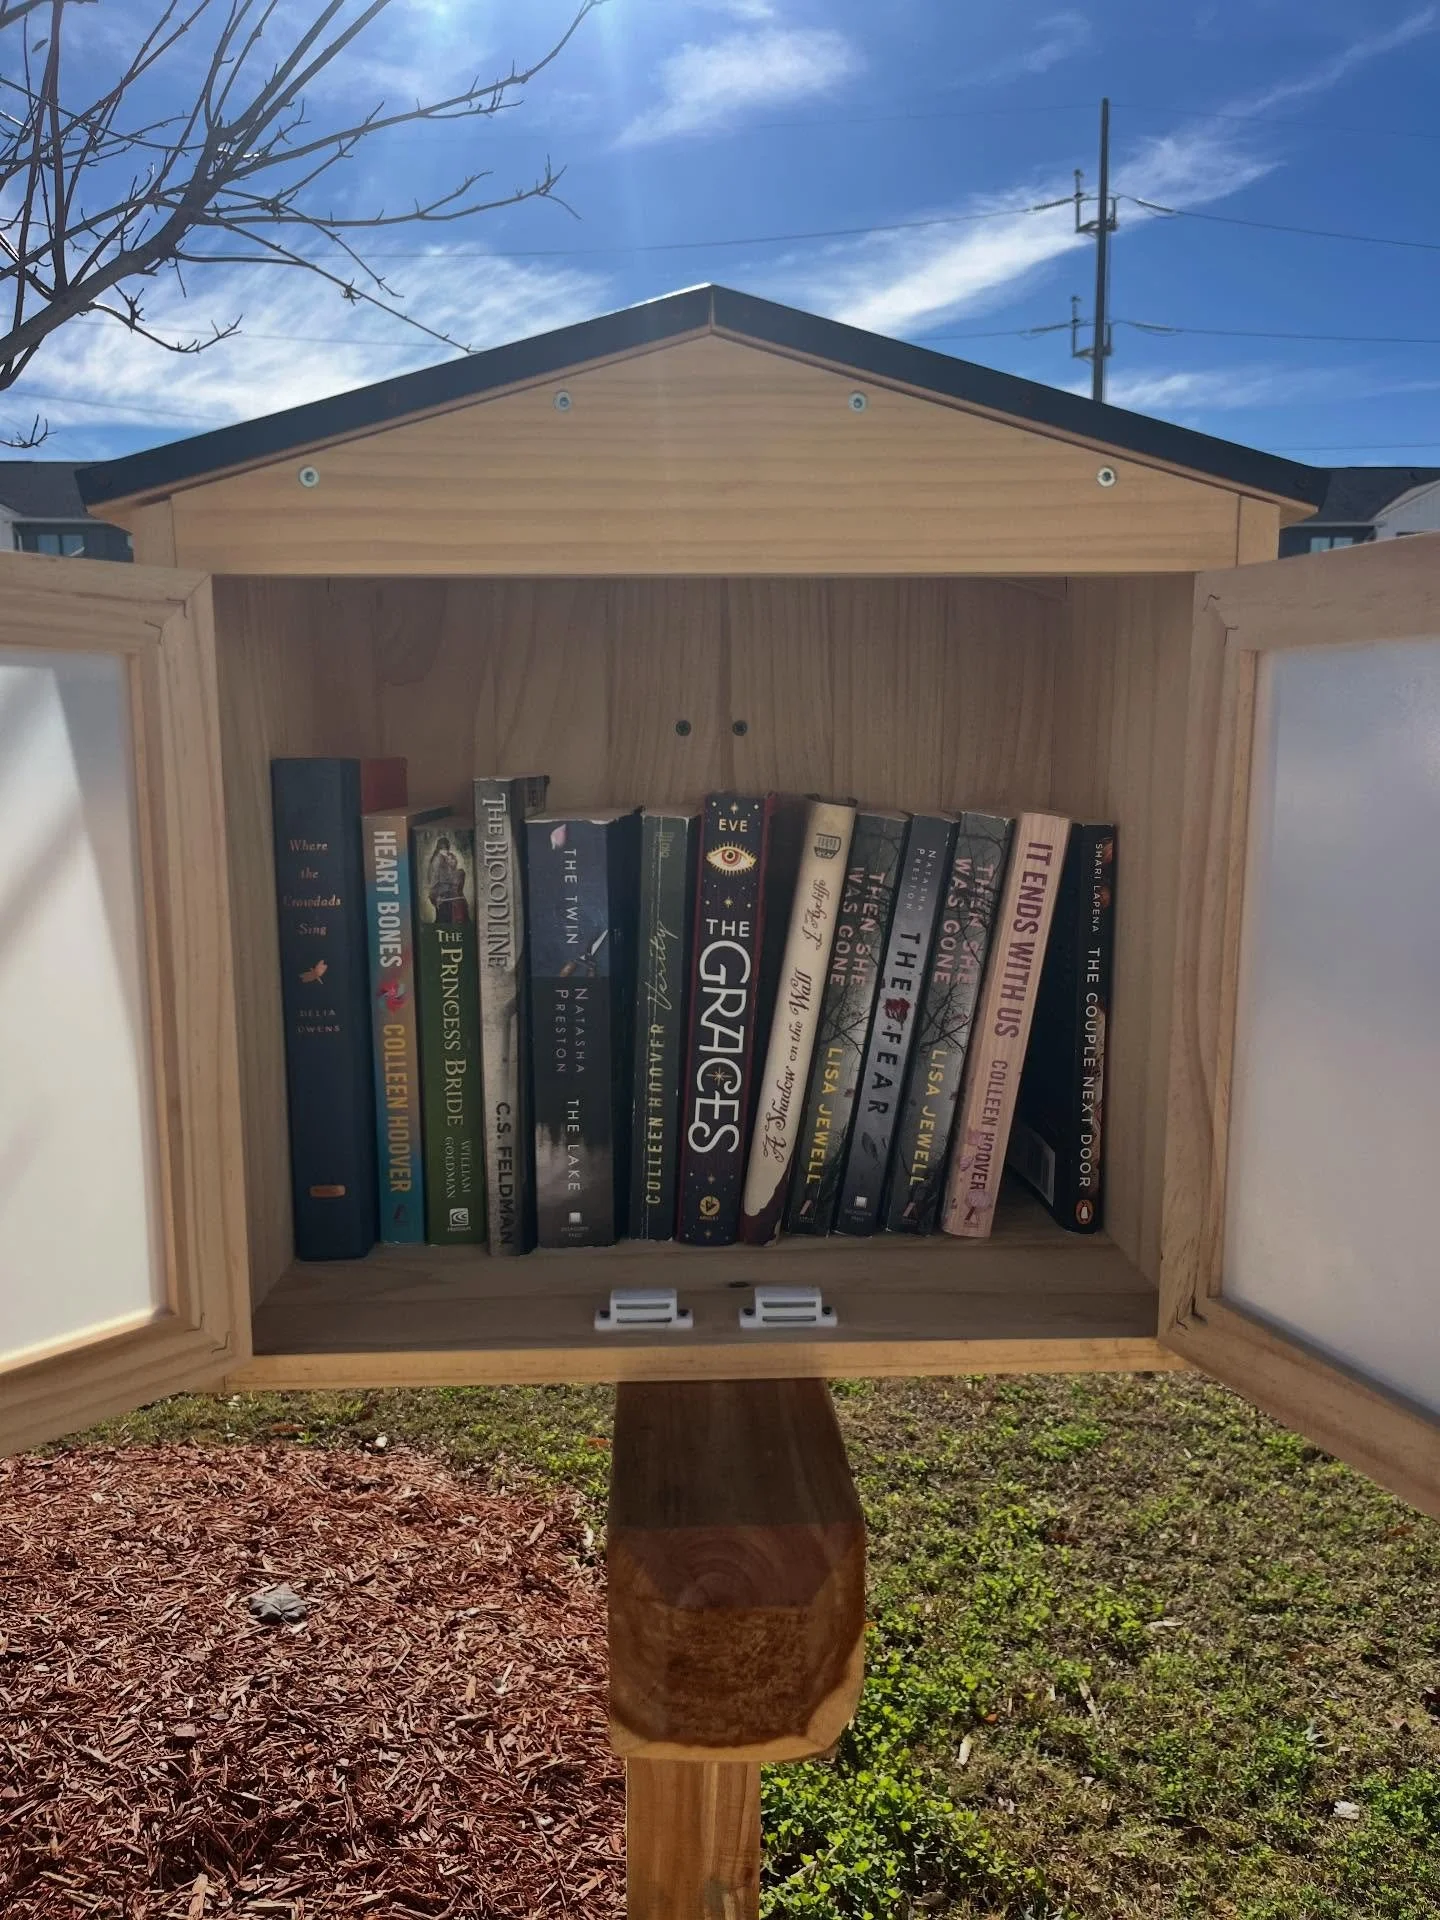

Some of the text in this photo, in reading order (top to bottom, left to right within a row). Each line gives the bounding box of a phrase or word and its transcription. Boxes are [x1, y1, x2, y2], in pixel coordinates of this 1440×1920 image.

[288, 839, 328, 852] Where
[300, 867, 319, 880] the
[718, 818, 748, 833] EVE
[298, 922, 327, 937] Sing
[373, 830, 403, 969] HEART BONES
[482, 793, 515, 969] THE BLOODLINE
[564, 848, 579, 945] THE TWIN
[830, 867, 865, 986] WAS GONE
[850, 872, 885, 986] THEN SHE
[933, 857, 973, 985] WAS GONE
[1091, 843, 1103, 933] SHARI LAPENA
[436, 929, 464, 943] THE
[641, 919, 679, 1011] Verity
[956, 940, 980, 985] SHE
[994, 842, 1053, 1038] IT ENDS WITH US
[297, 1023, 341, 1033] OWENS
[440, 948, 467, 1127] PRINCESS BRIDE
[555, 988, 569, 1073] PRESTON
[575, 988, 588, 1073] NATASHA
[688, 918, 752, 1153] THE GRACES
[763, 967, 812, 1163] A Shadow on the Wall
[867, 933, 921, 1115] THE FEAR
[1078, 947, 1100, 1188] THE COUPLE NEXT DOOR
[383, 1024, 412, 1193] COLLEEN HOOVER
[646, 1023, 666, 1205] COLLEEN HOOVER
[806, 1047, 843, 1184] LISA JEWELL
[909, 1049, 948, 1186] LISA JEWELL
[982, 1059, 1008, 1127] COLLEEN
[445, 1136, 456, 1199] GOLDMAN
[461, 1139, 472, 1194] WILLIAM
[495, 1101, 514, 1246] C.S. FELDMAN
[567, 1099, 581, 1191] THE LAKE
[969, 1132, 995, 1190] HOOVER
